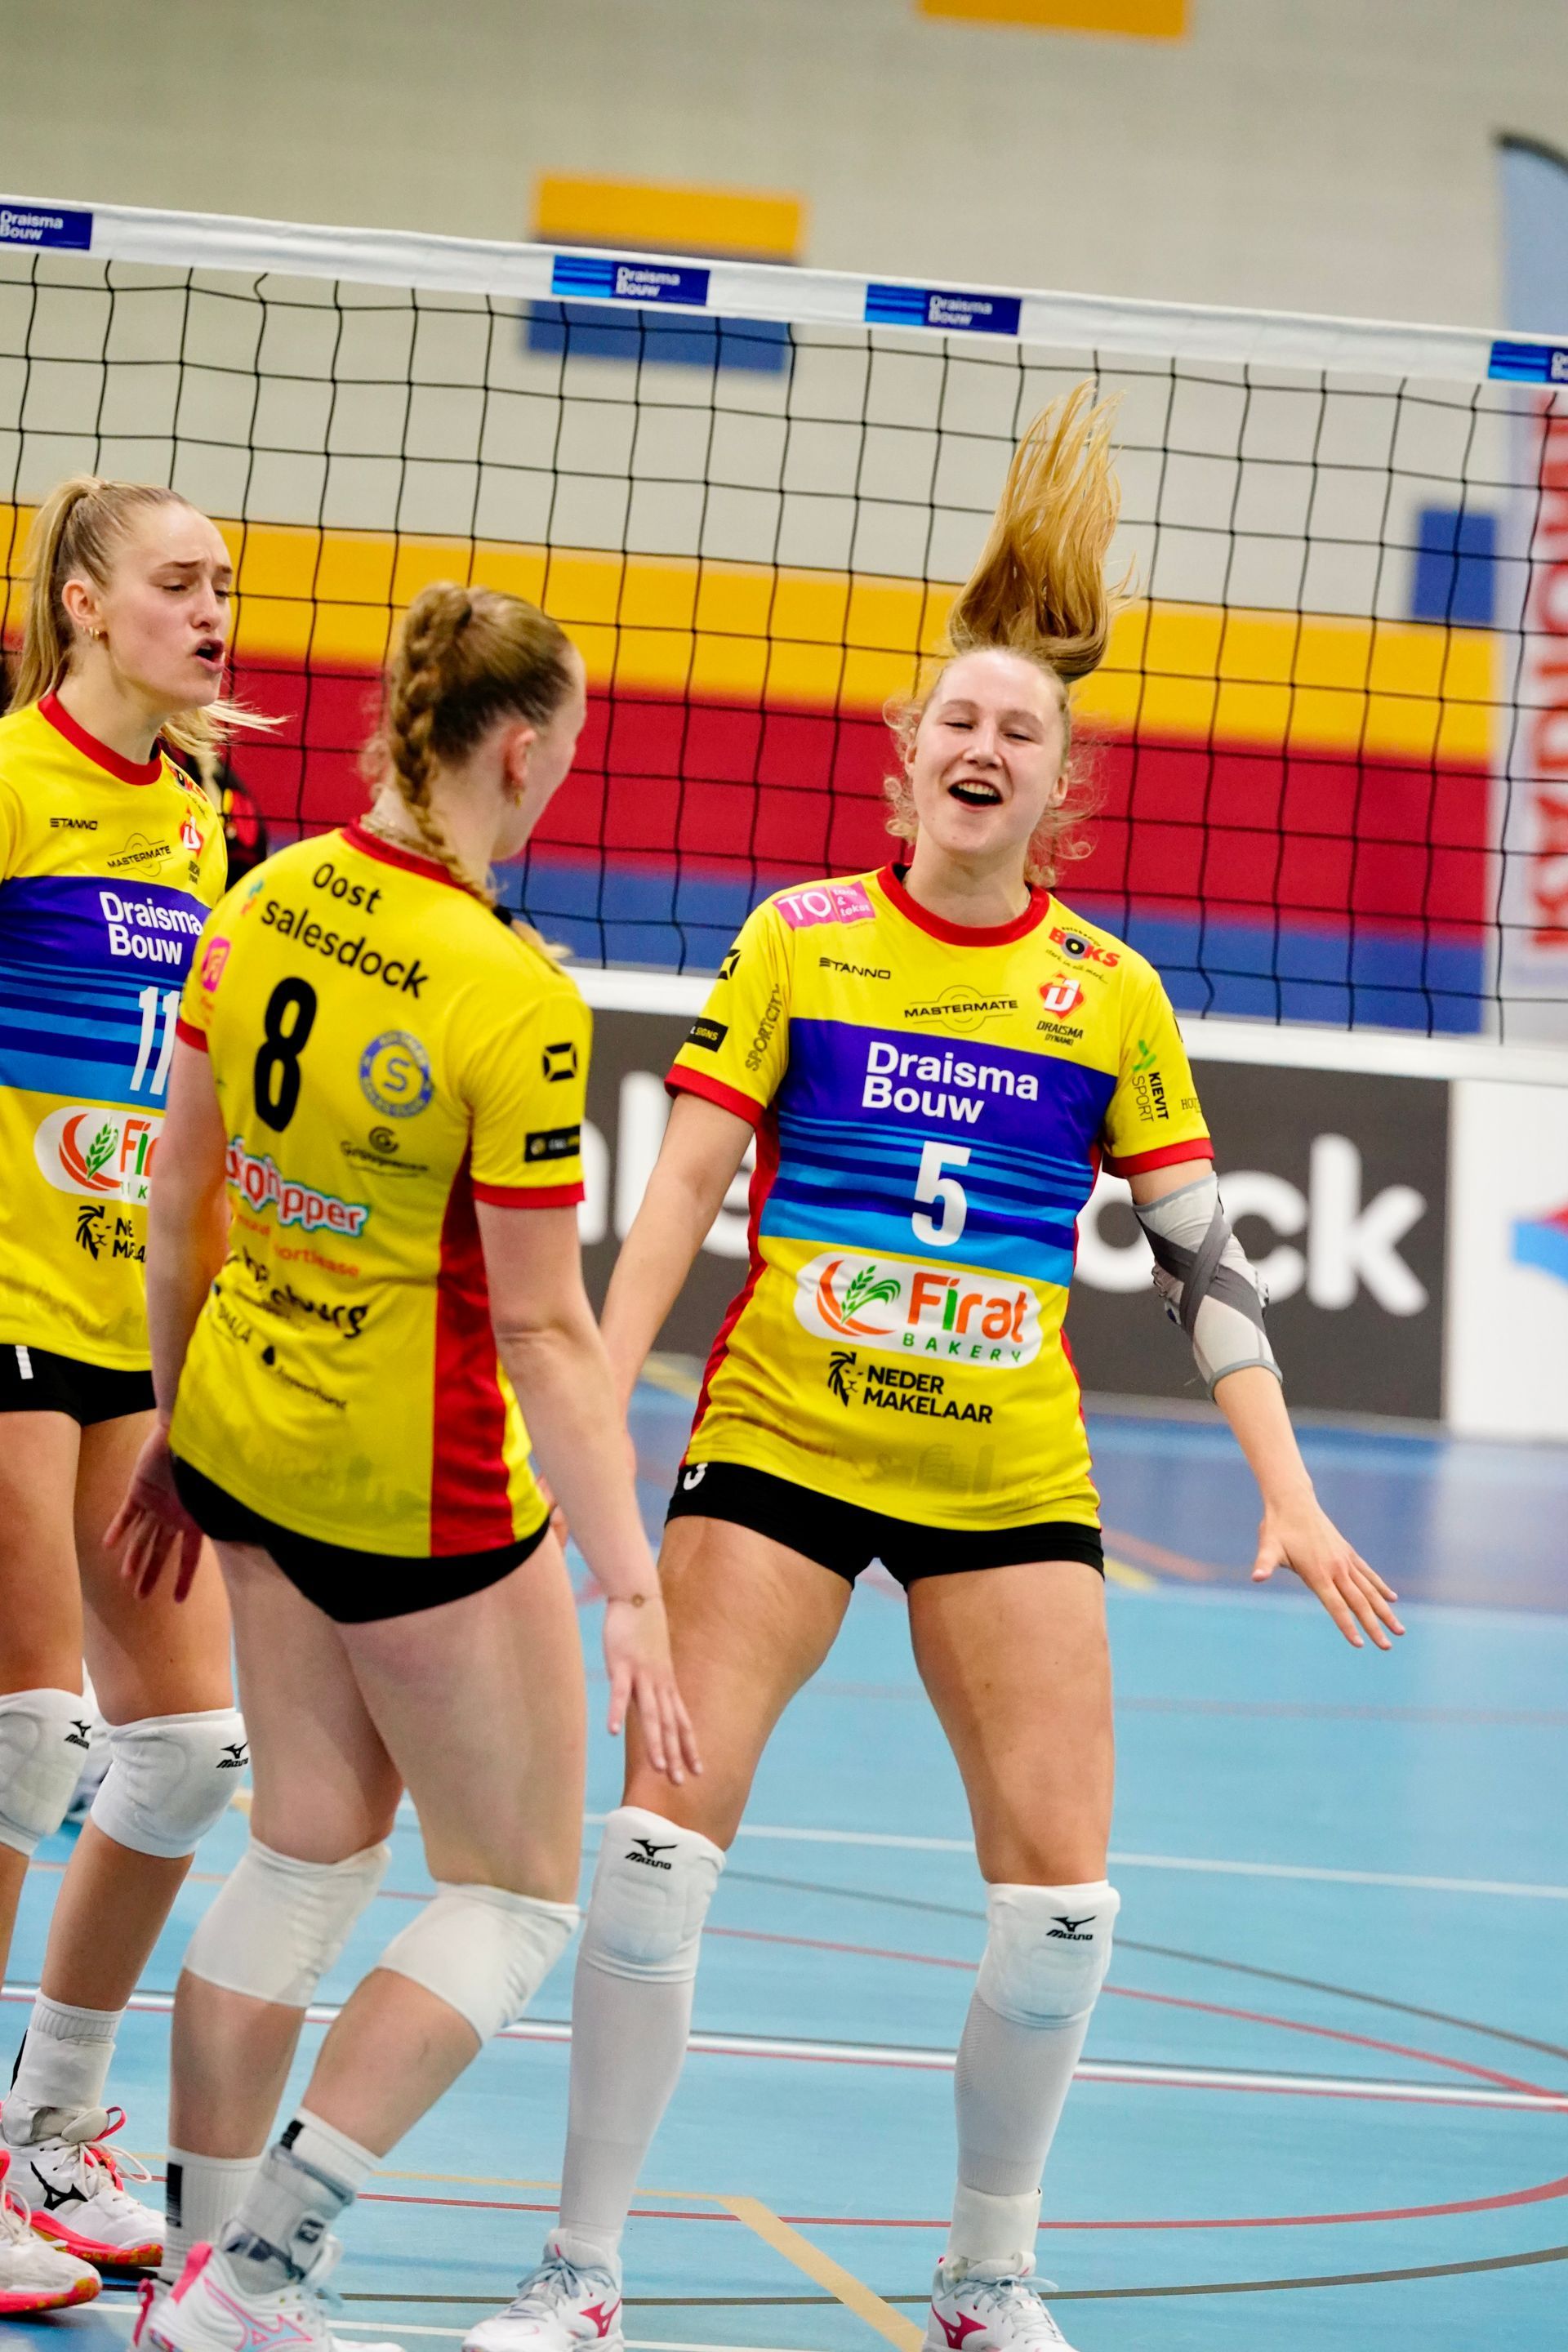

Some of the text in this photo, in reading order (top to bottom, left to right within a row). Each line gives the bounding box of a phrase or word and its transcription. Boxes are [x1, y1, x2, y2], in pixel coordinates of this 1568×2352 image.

[0, 210, 64, 229] Draisma
[0, 224, 43, 241] Bouw
[617, 266, 681, 286] Draisma
[107, 845, 172, 869] MASTERMATE
[314, 862, 382, 915] Oost
[777, 891, 831, 921] TO
[99, 891, 203, 936] Draisma
[108, 924, 182, 965] Bouw
[261, 898, 430, 1000] salesdock
[1049, 926, 1121, 968] BOKS
[819, 957, 891, 980] STANNO
[744, 982, 783, 1072] SPORTCITY
[904, 998, 1019, 1019] MASTERMATE
[1036, 1019, 1084, 1040] DRAISMA
[129, 985, 181, 1095] 11
[254, 977, 317, 1133] 8
[866, 1040, 1039, 1102] Draisma
[861, 1074, 985, 1125] Bouw
[1131, 1075, 1154, 1122] SPORT
[1148, 1071, 1169, 1120] KIEVIT
[911, 1140, 972, 1248] 5
[906, 1271, 1028, 1343] Firat
[902, 1332, 1022, 1363] BAKERY
[866, 1365, 945, 1395] NEDER
[863, 1387, 994, 1424] MAKELAAR
